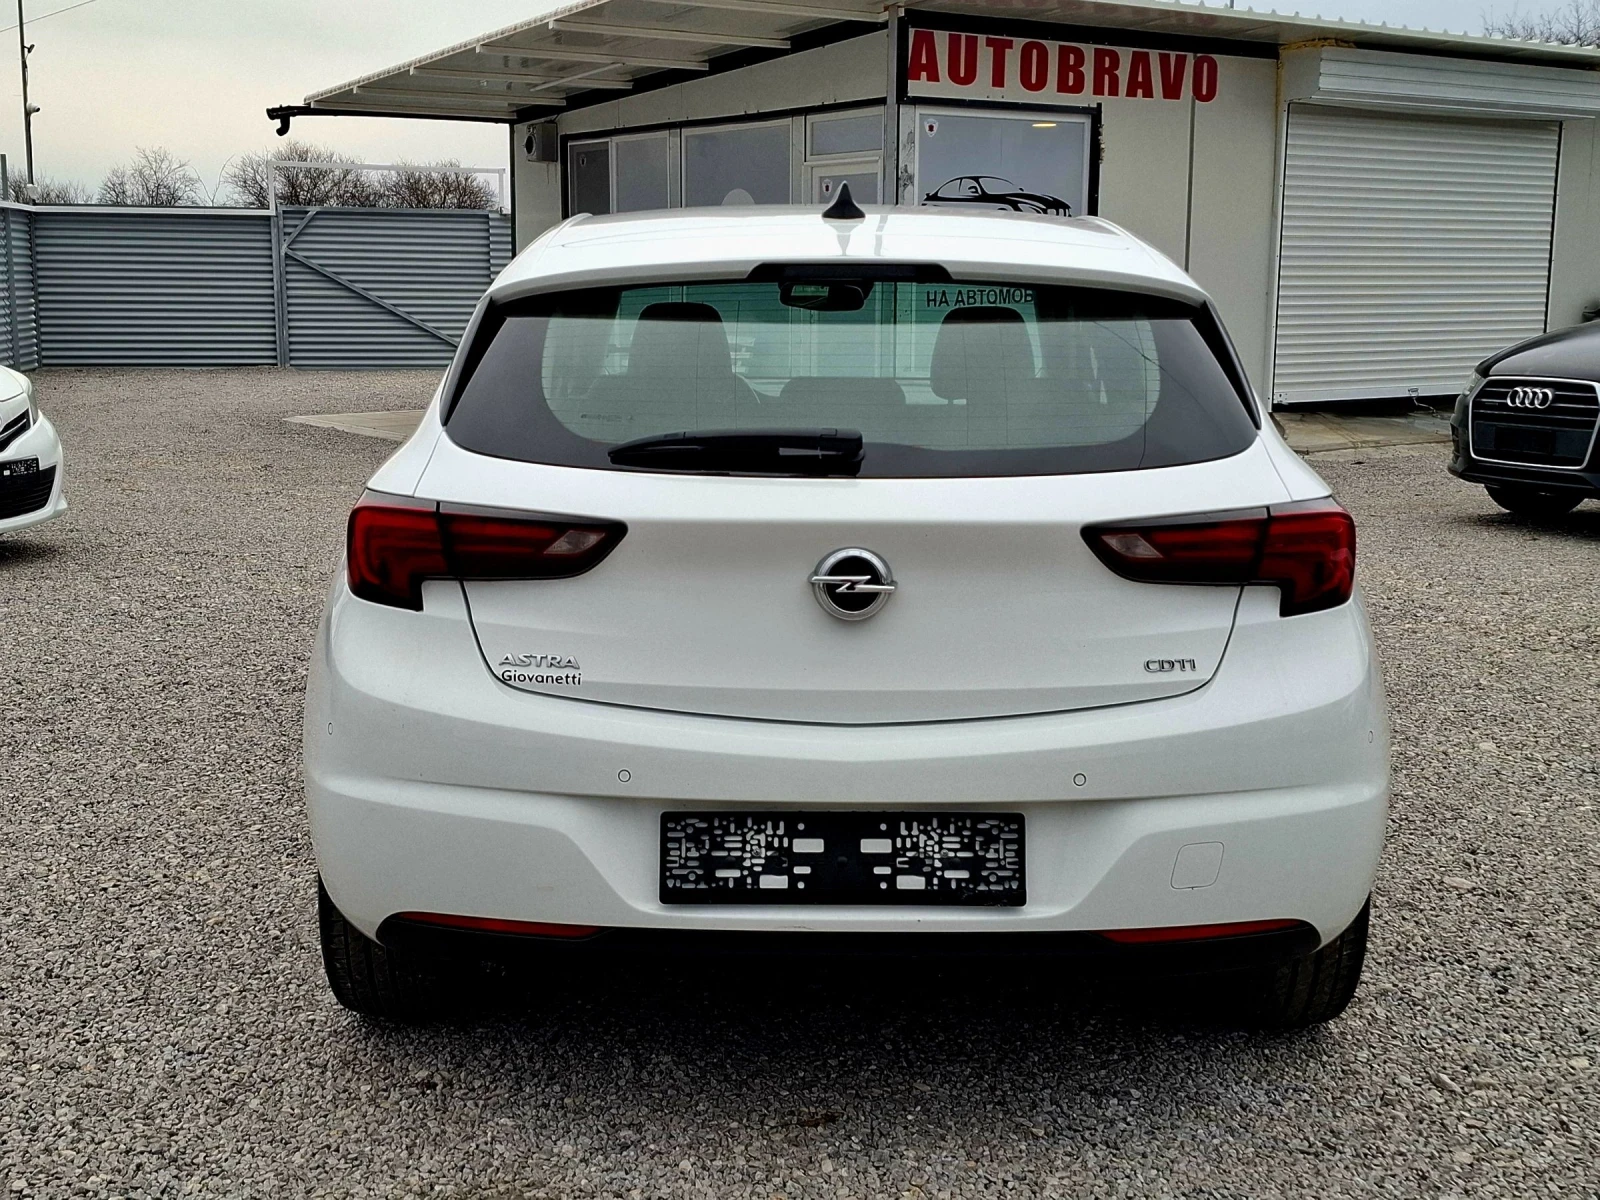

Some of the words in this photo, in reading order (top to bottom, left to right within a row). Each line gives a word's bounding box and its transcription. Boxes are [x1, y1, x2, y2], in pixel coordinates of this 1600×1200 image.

[908, 29, 1218, 103] AUTOBRAVO
[926, 289, 950, 307] НА
[499, 653, 580, 669] ASTRA
[1143, 658, 1196, 673] CDTI
[501, 669, 582, 685] Giovanetti
